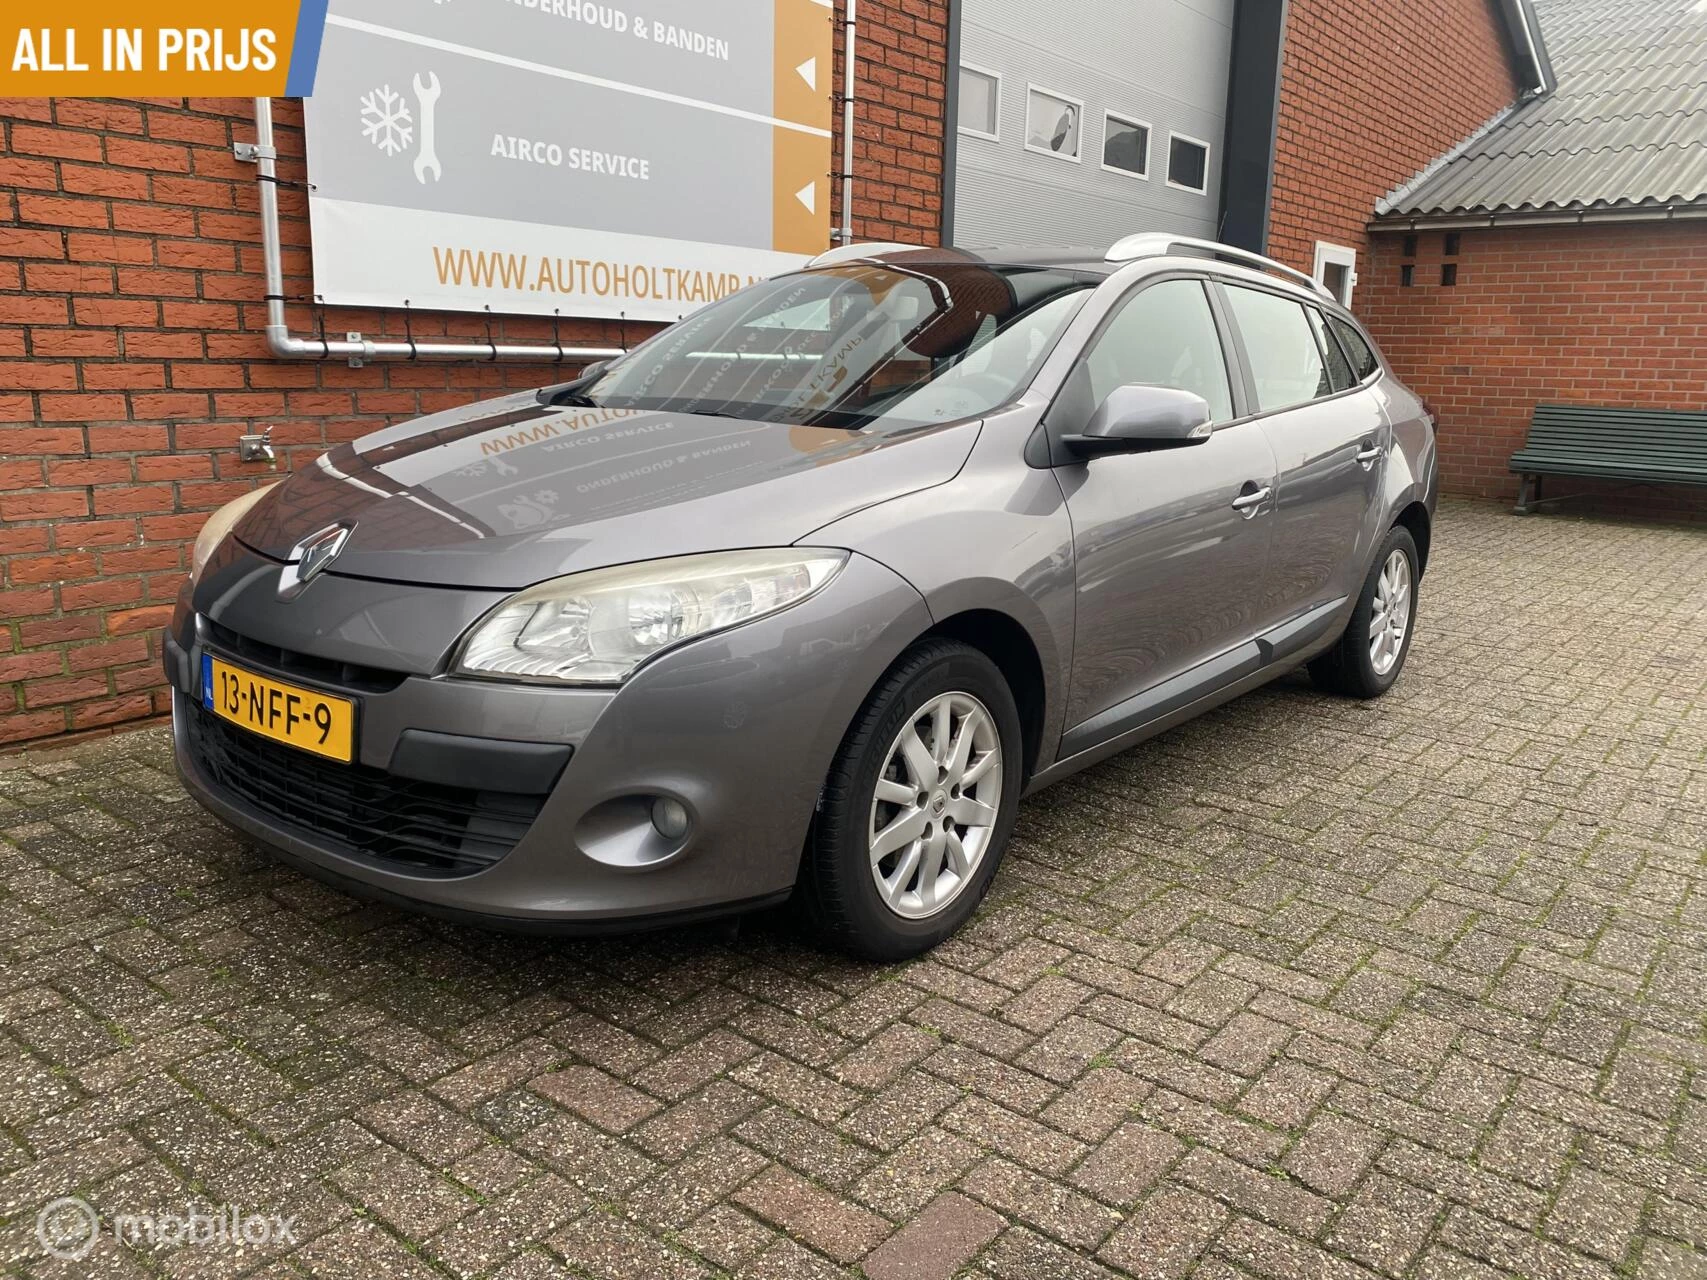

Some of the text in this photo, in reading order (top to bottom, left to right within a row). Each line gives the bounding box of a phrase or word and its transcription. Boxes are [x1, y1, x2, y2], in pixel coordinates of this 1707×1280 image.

[633, 16, 648, 39] &
[654, 21, 729, 60] BANDEN
[491, 134, 650, 181] AIRCO SERVICE
[432, 246, 766, 303] WWW.AUTOHOLTKAMP
[221, 671, 332, 745] 13-NFF-9
